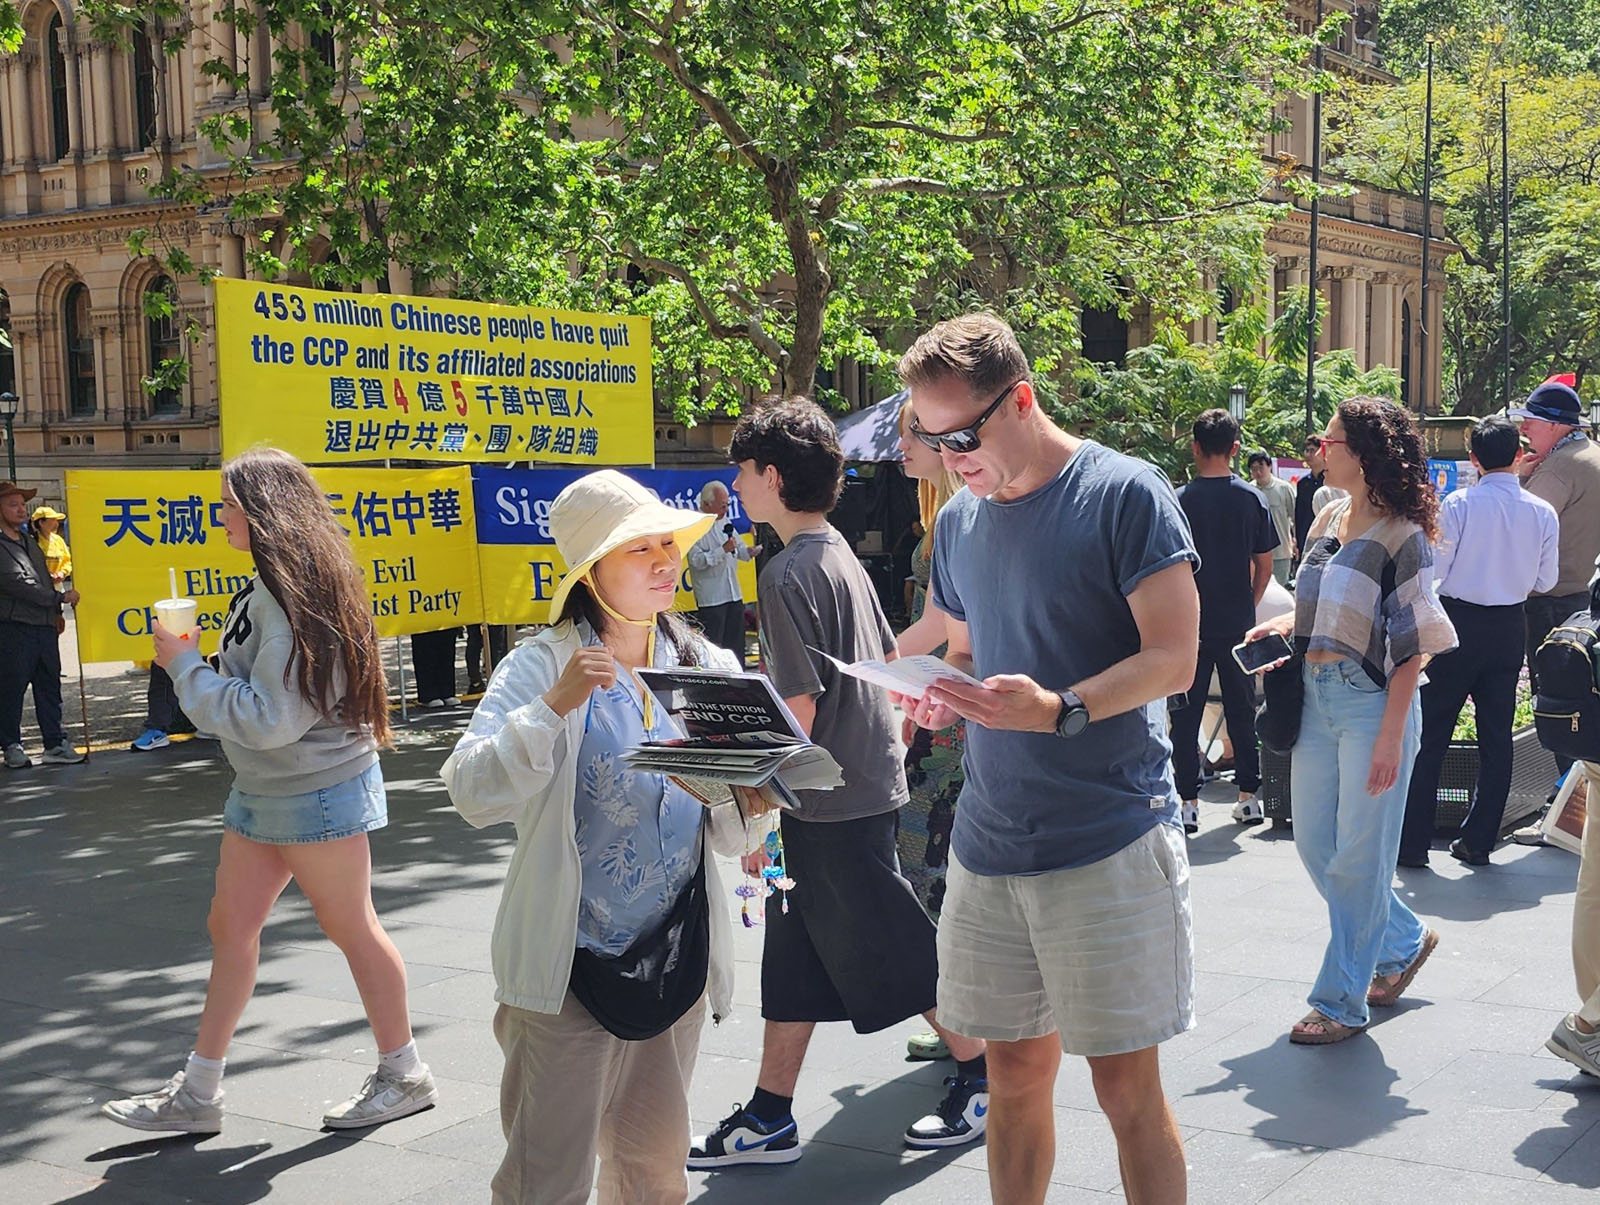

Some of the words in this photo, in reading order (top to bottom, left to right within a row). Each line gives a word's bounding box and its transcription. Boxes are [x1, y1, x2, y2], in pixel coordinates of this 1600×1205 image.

[254, 291, 307, 323] 453
[313, 298, 384, 329] million
[390, 302, 482, 336] Chinese
[488, 314, 546, 344] people
[551, 316, 595, 345] have
[599, 323, 630, 351] quit
[251, 334, 295, 364] the
[303, 336, 349, 367] CCP
[356, 343, 389, 370] and
[398, 343, 430, 373] its
[436, 349, 526, 378] affiliated
[530, 357, 637, 384] associations
[184, 567, 258, 597] Elim
[372, 556, 417, 584] Evil
[408, 588, 462, 617] Party
[680, 710, 724, 722] END
[727, 714, 772, 726] CCP
[697, 702, 720, 712] THE
[719, 704, 767, 714] PETITION
